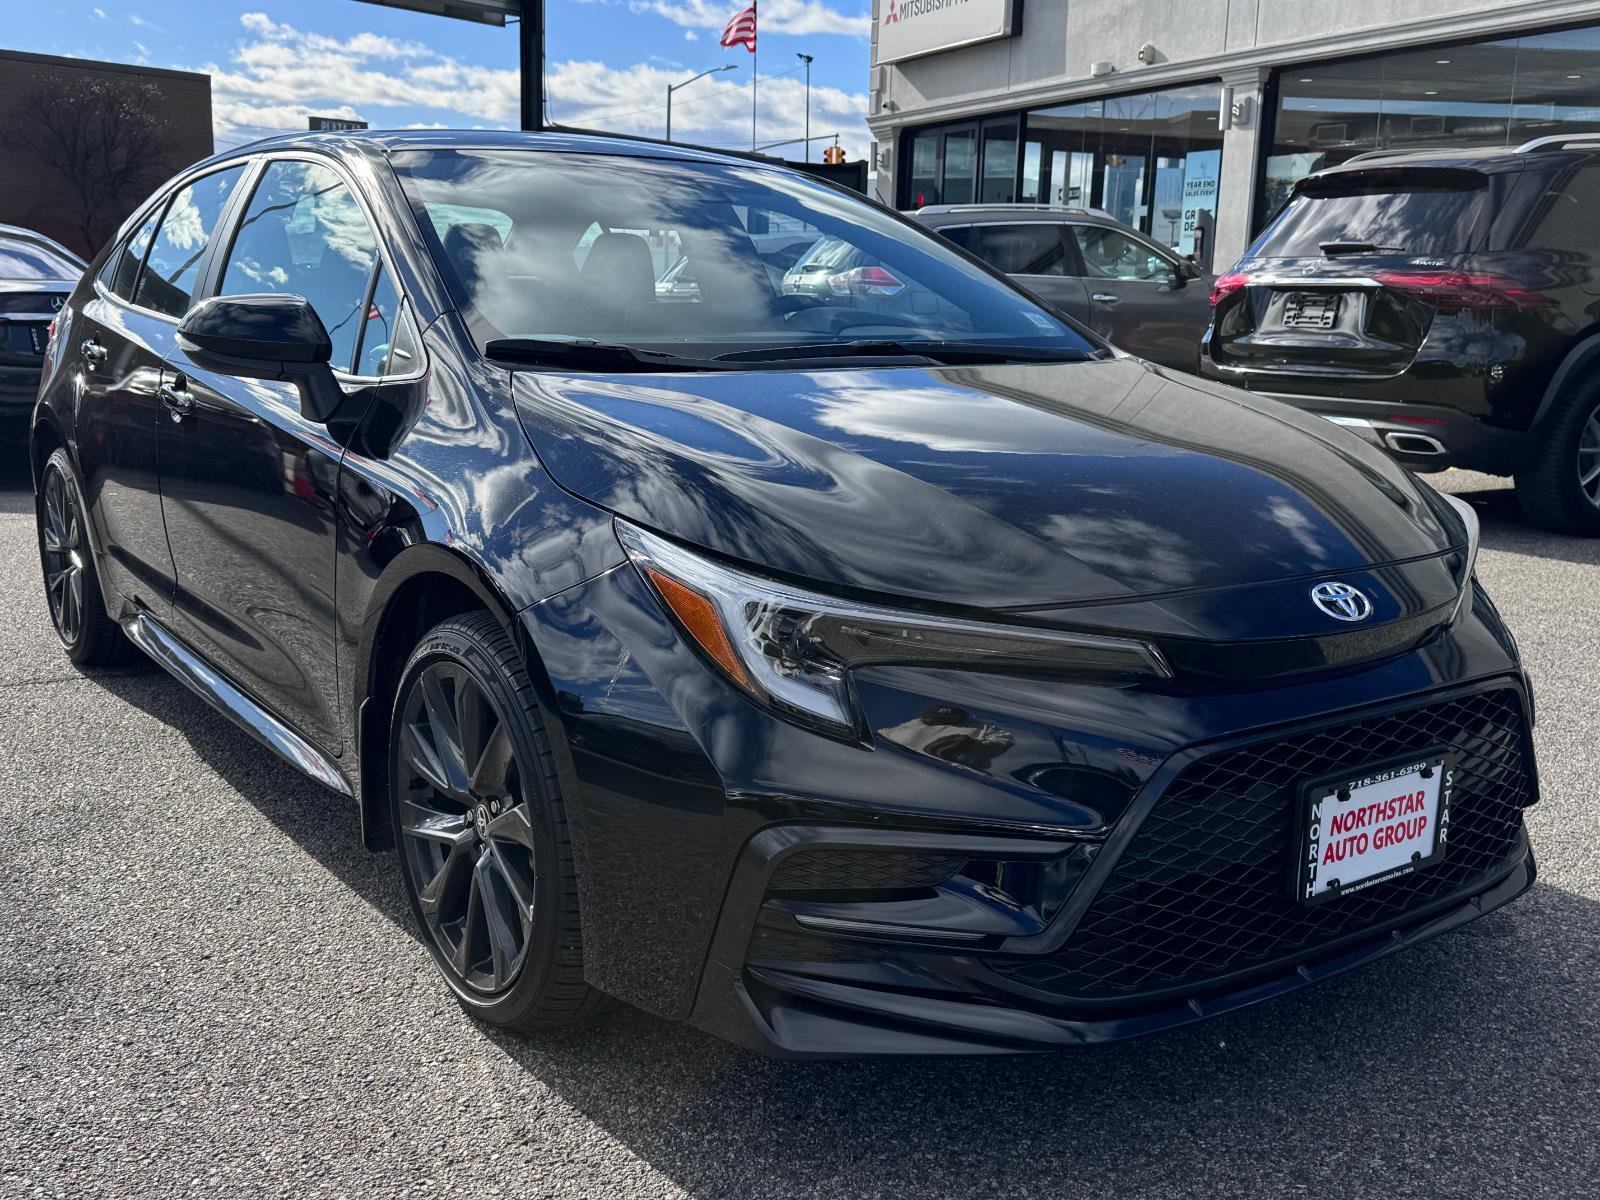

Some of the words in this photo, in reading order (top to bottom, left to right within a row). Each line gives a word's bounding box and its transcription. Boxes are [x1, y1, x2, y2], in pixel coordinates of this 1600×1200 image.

[1186, 181, 1202, 189] YEAR
[1203, 180, 1215, 188] END
[1200, 189, 1215, 197] EVENT
[1348, 762, 1427, 790] 718-361-6299
[1330, 790, 1425, 837] NORTHSTAR
[1439, 770, 1453, 844] STAR
[1305, 802, 1323, 899] NORTH
[1322, 833, 1368, 866] AUTO
[1373, 815, 1427, 850] GROUP
